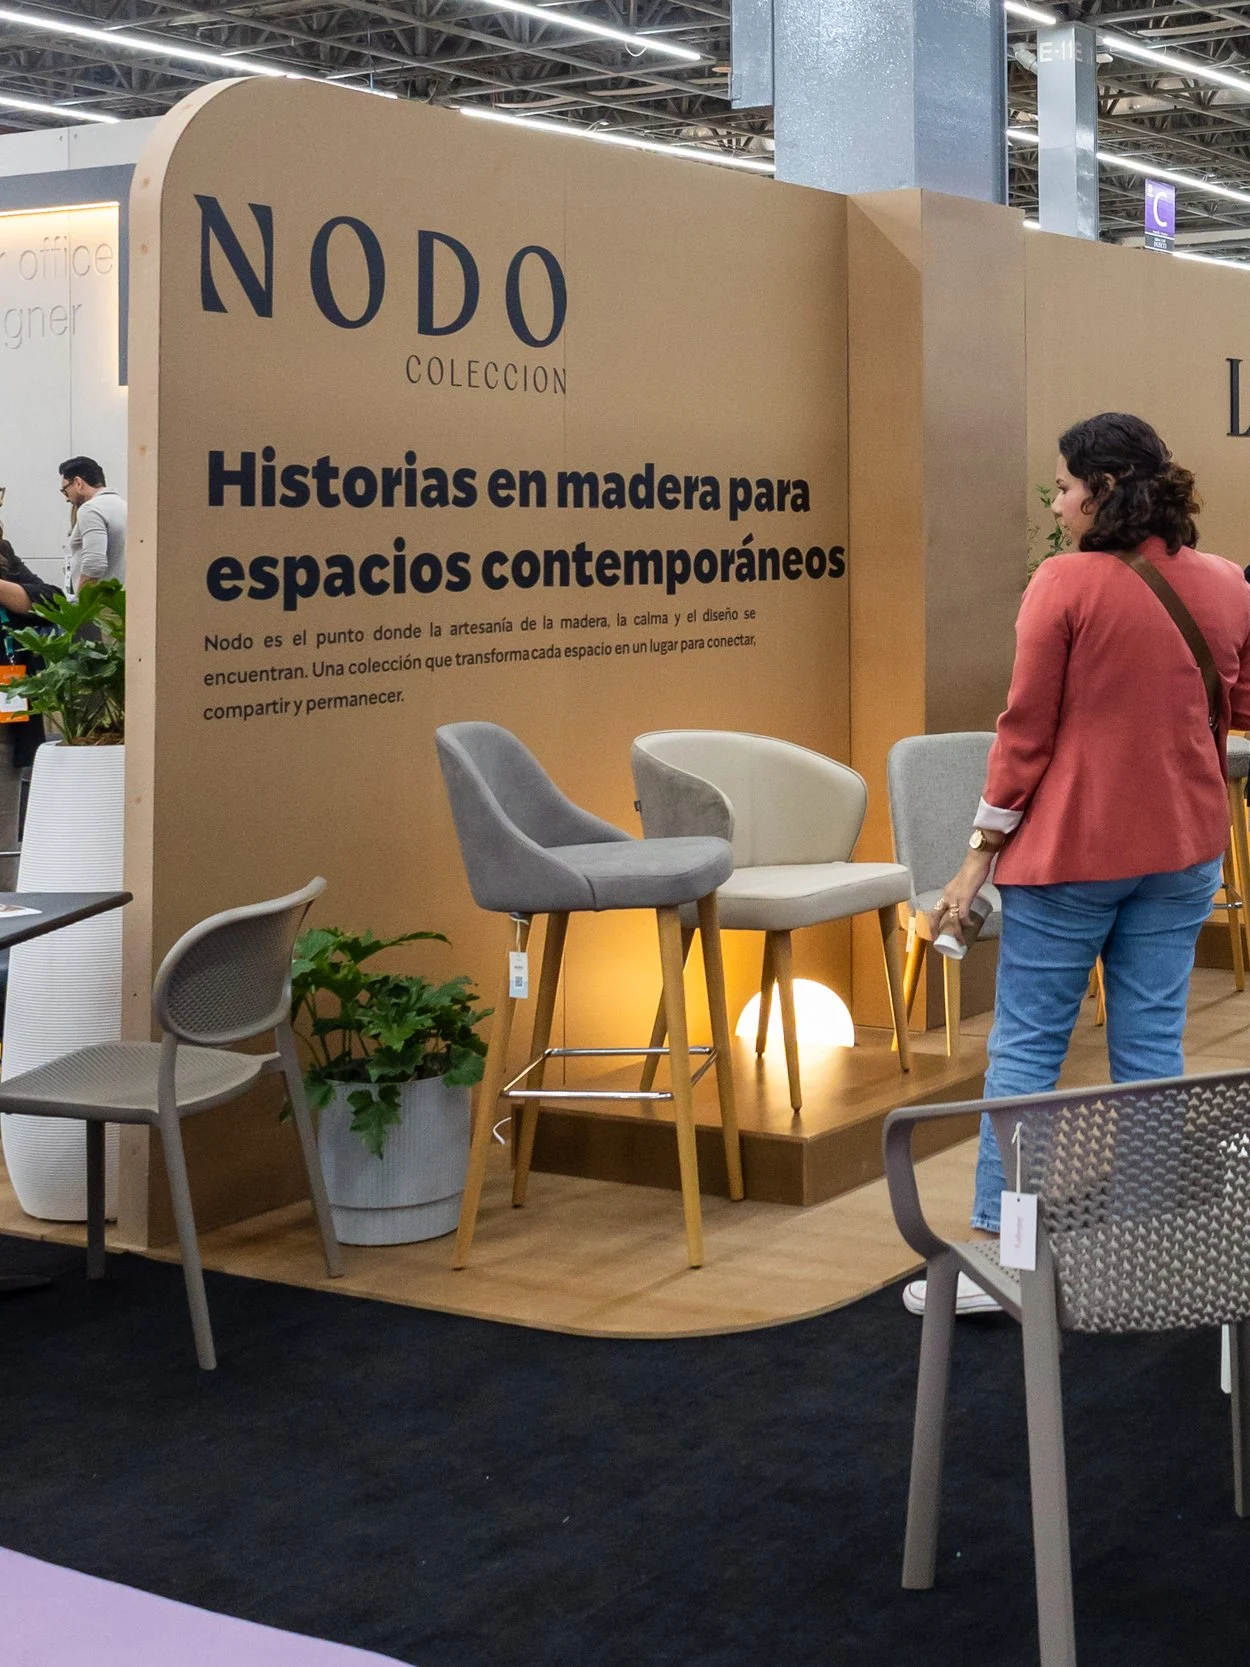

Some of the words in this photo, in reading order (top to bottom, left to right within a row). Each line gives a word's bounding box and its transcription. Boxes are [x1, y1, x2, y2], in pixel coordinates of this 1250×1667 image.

[1153, 191, 1168, 228] C
[19, 236, 114, 281] office
[193, 193, 568, 349] NODO
[405, 354, 568, 396] COLECCION
[208, 445, 478, 508] Historias
[487, 467, 547, 508] en
[557, 462, 721, 511] madera
[729, 476, 811, 521] para
[206, 536, 472, 611] espacios
[481, 532, 846, 595] contemporáneos
[204, 633, 254, 651] Nodo
[263, 635, 283, 648] es
[292, 630, 307, 647] el
[316, 628, 364, 649] punto
[373, 623, 422, 641] donde
[429, 622, 442, 638] la
[450, 616, 513, 636] artesanía
[520, 616, 537, 632] de
[543, 615, 553, 630] la
[560, 614, 611, 630] madera,
[617, 612, 627, 627] la
[633, 611, 669, 627] calma
[674, 612, 681, 627] y
[686, 609, 697, 624] el
[702, 607, 739, 623] diseño
[743, 608, 756, 620] se
[204, 665, 308, 687] encuentran.
[312, 661, 344, 678] Una
[348, 653, 422, 675] colección
[425, 655, 452, 672] que
[455, 646, 530, 667] transforma
[531, 644, 562, 660] cada
[564, 641, 613, 661] espacio
[615, 642, 630, 655] en
[632, 641, 648, 654] un
[650, 638, 679, 656] lugar
[680, 638, 705, 653] para
[707, 633, 756, 650] conectar,
[203, 696, 290, 722] compartir
[293, 699, 301, 717] y
[306, 690, 405, 713] permanecer.
